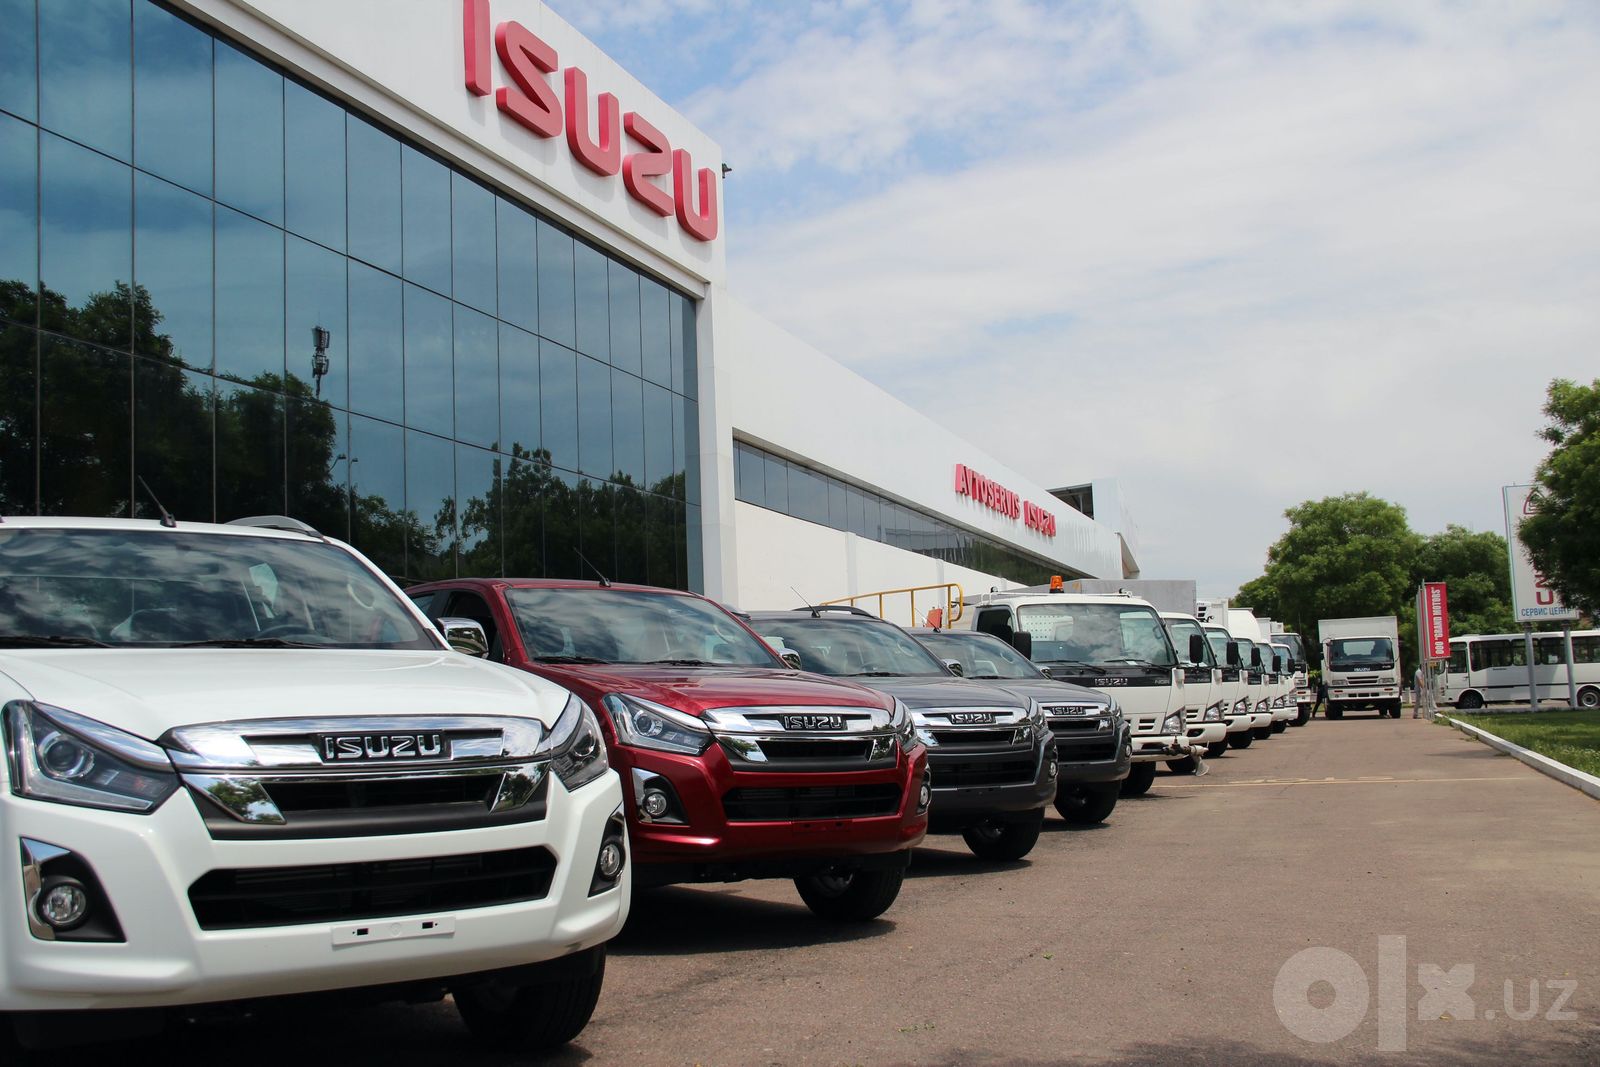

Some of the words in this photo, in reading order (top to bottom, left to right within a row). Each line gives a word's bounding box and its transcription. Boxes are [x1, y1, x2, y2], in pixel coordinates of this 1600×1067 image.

[463, 0, 718, 242] ISUZU
[955, 463, 1020, 520] AVTOSERVIS
[1023, 500, 1056, 538] ISUZU
[1521, 607, 1548, 617] СЕРВИС
[1094, 678, 1128, 686] ISUZU
[1052, 706, 1084, 715] ISUZU
[784, 715, 842, 729] ISUZU
[951, 713, 994, 724] ISUZU
[325, 734, 441, 759] ISUZU
